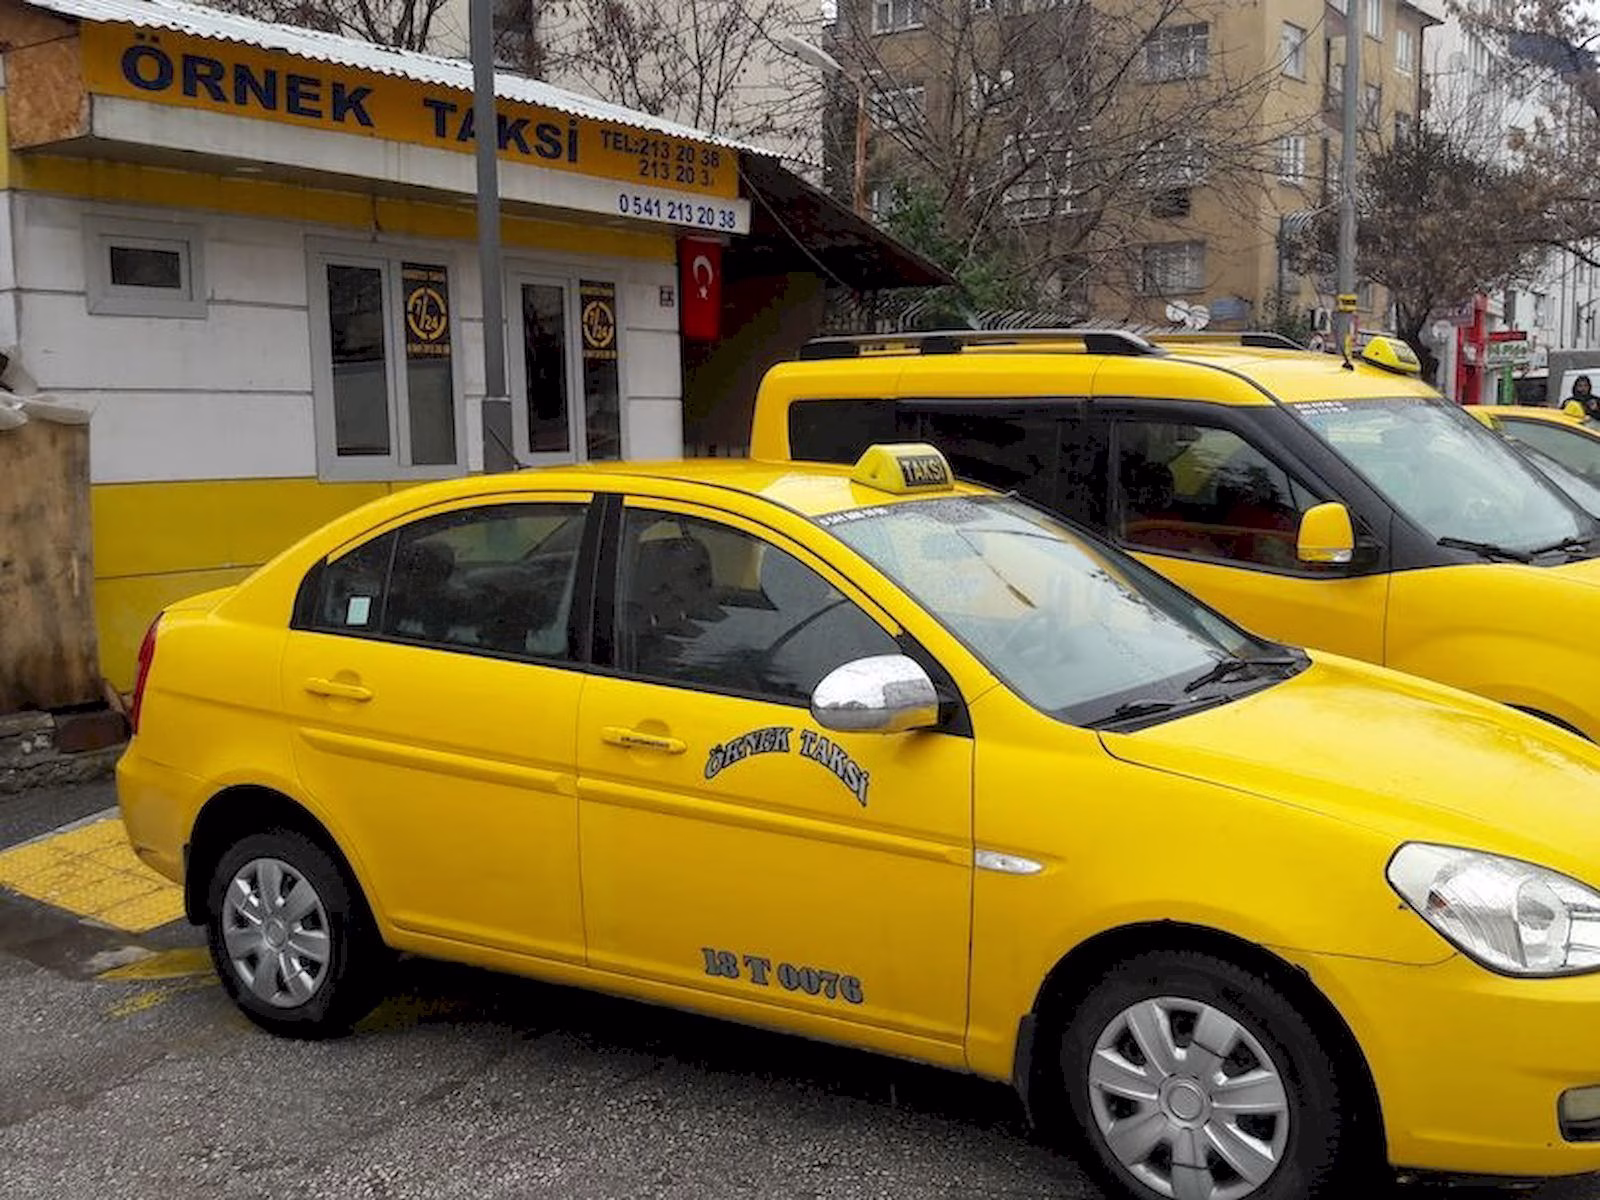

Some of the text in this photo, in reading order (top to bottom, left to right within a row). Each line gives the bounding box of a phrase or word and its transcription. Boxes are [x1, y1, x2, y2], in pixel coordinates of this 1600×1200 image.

[121, 31, 376, 129] ÖRNEK
[639, 159, 715, 186] 213 20 3
[675, 145, 695, 164] 20
[700, 150, 720, 169] 38
[619, 193, 736, 229] 0 541 213 20 38
[704, 726, 870, 807] ÖRNEK TAKSİ
[701, 947, 864, 1004] 18 T 0076
